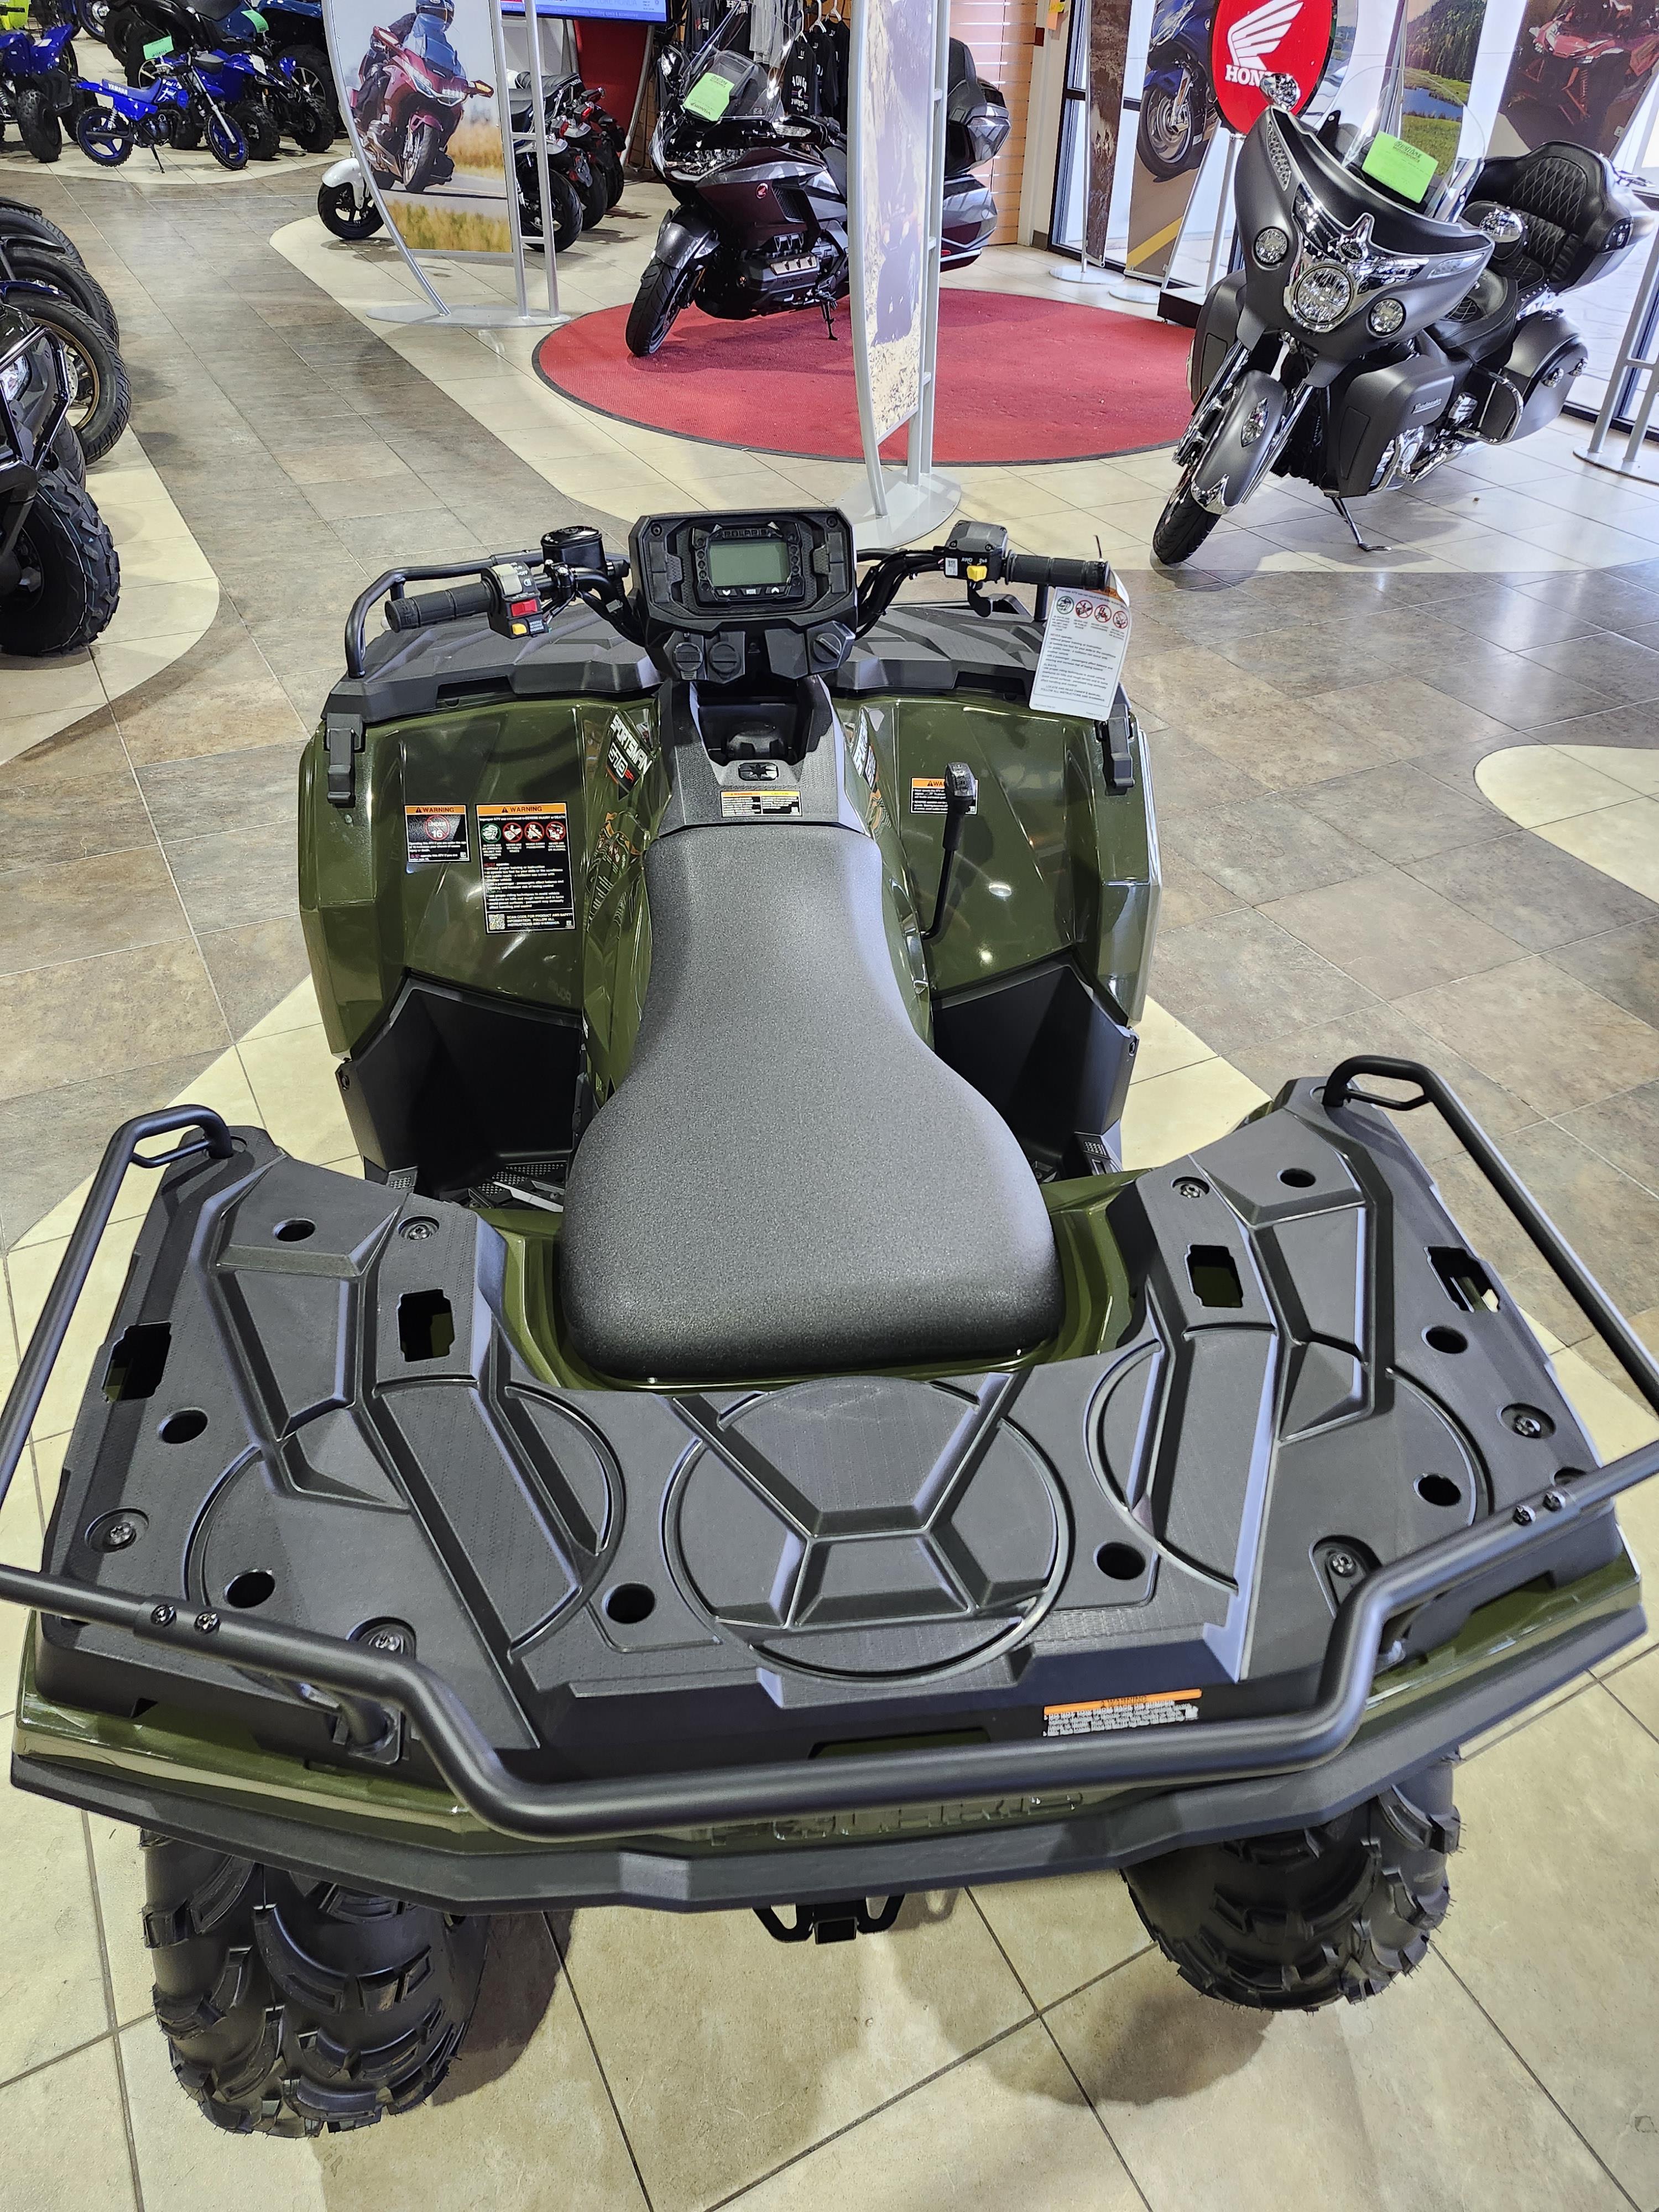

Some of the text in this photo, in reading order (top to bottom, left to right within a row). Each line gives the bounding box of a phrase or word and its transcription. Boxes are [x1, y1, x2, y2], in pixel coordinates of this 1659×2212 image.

[1225, 64, 1276, 87] HON
[108, 83, 128, 95] YAMAHA
[724, 529, 767, 537] POLARIS
[610, 714, 653, 775] SPORTSMAN
